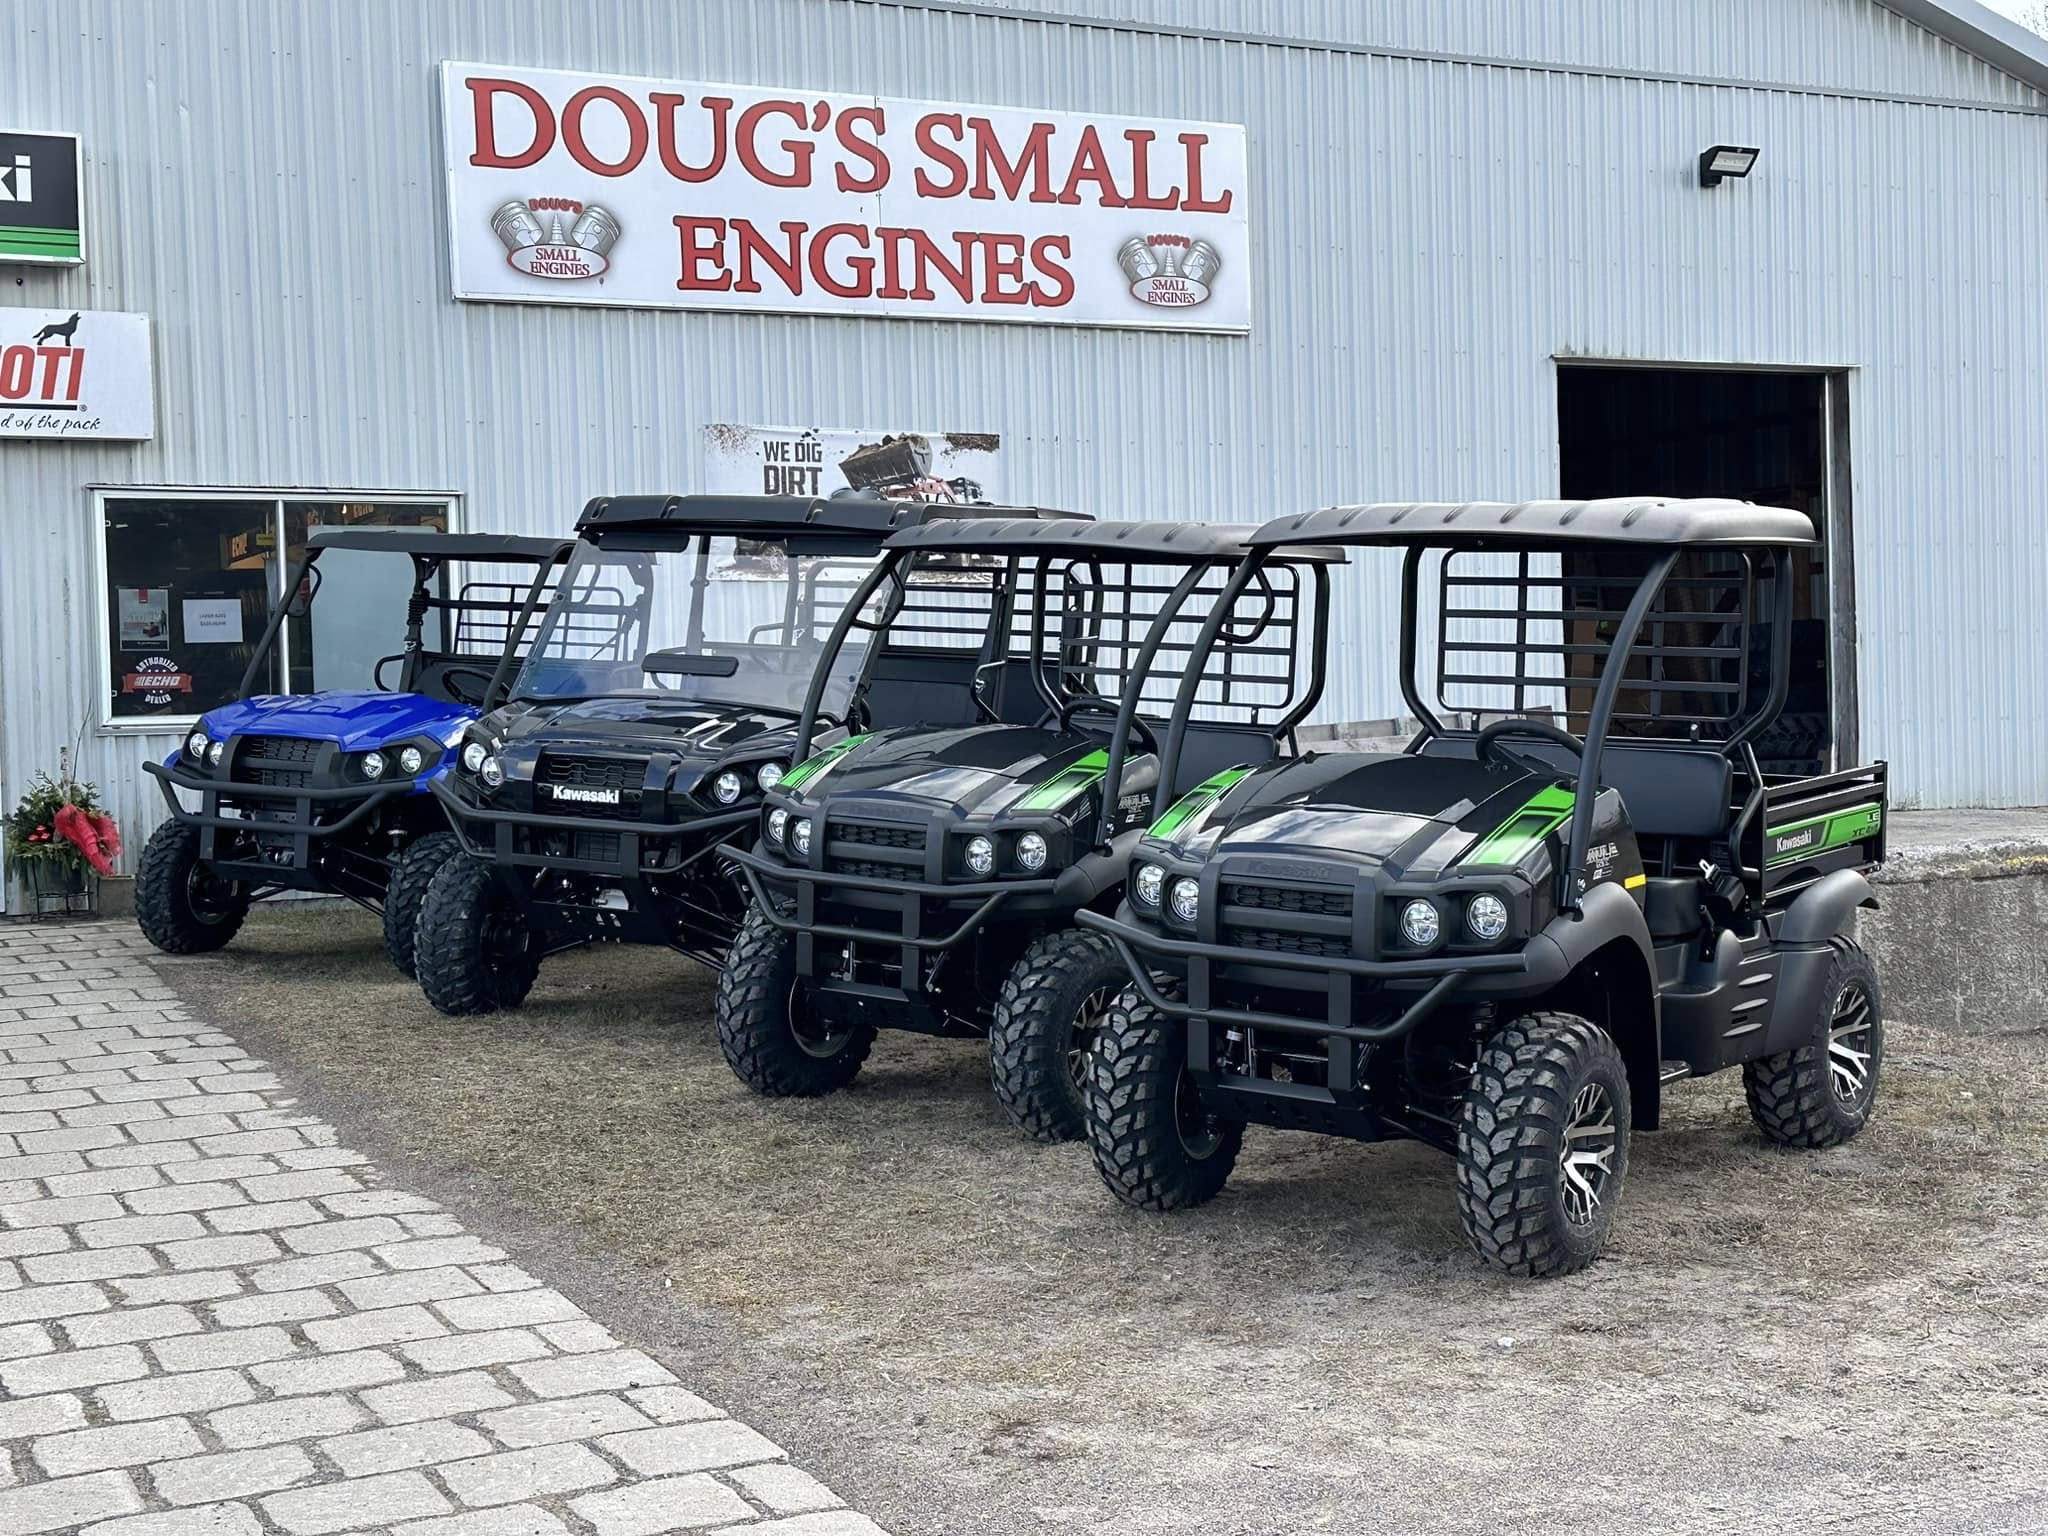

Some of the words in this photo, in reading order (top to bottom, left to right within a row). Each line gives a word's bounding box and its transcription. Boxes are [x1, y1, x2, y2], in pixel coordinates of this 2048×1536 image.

[465, 77, 891, 194] DOUG'S
[914, 113, 1232, 214] SMALL
[535, 247, 581, 262] SMALL
[673, 215, 1075, 307] ENGINES
[529, 261, 590, 276] ENGINES
[1152, 279, 1189, 292] SMALL
[1148, 291, 1196, 304] ENGINES
[0, 345, 85, 400] OTI
[15, 414, 37, 432] of
[37, 414, 60, 429] the
[60, 417, 101, 435] pack
[763, 441, 791, 463] WE
[794, 442, 823, 463] DIG
[763, 465, 823, 496] DIRT
[135, 656, 179, 673] AUTHORIZED
[143, 675, 181, 687] ECHO
[144, 694, 172, 704] DEALER
[553, 784, 619, 804] Kawasaki
[1776, 829, 1812, 853] Kawasaki
